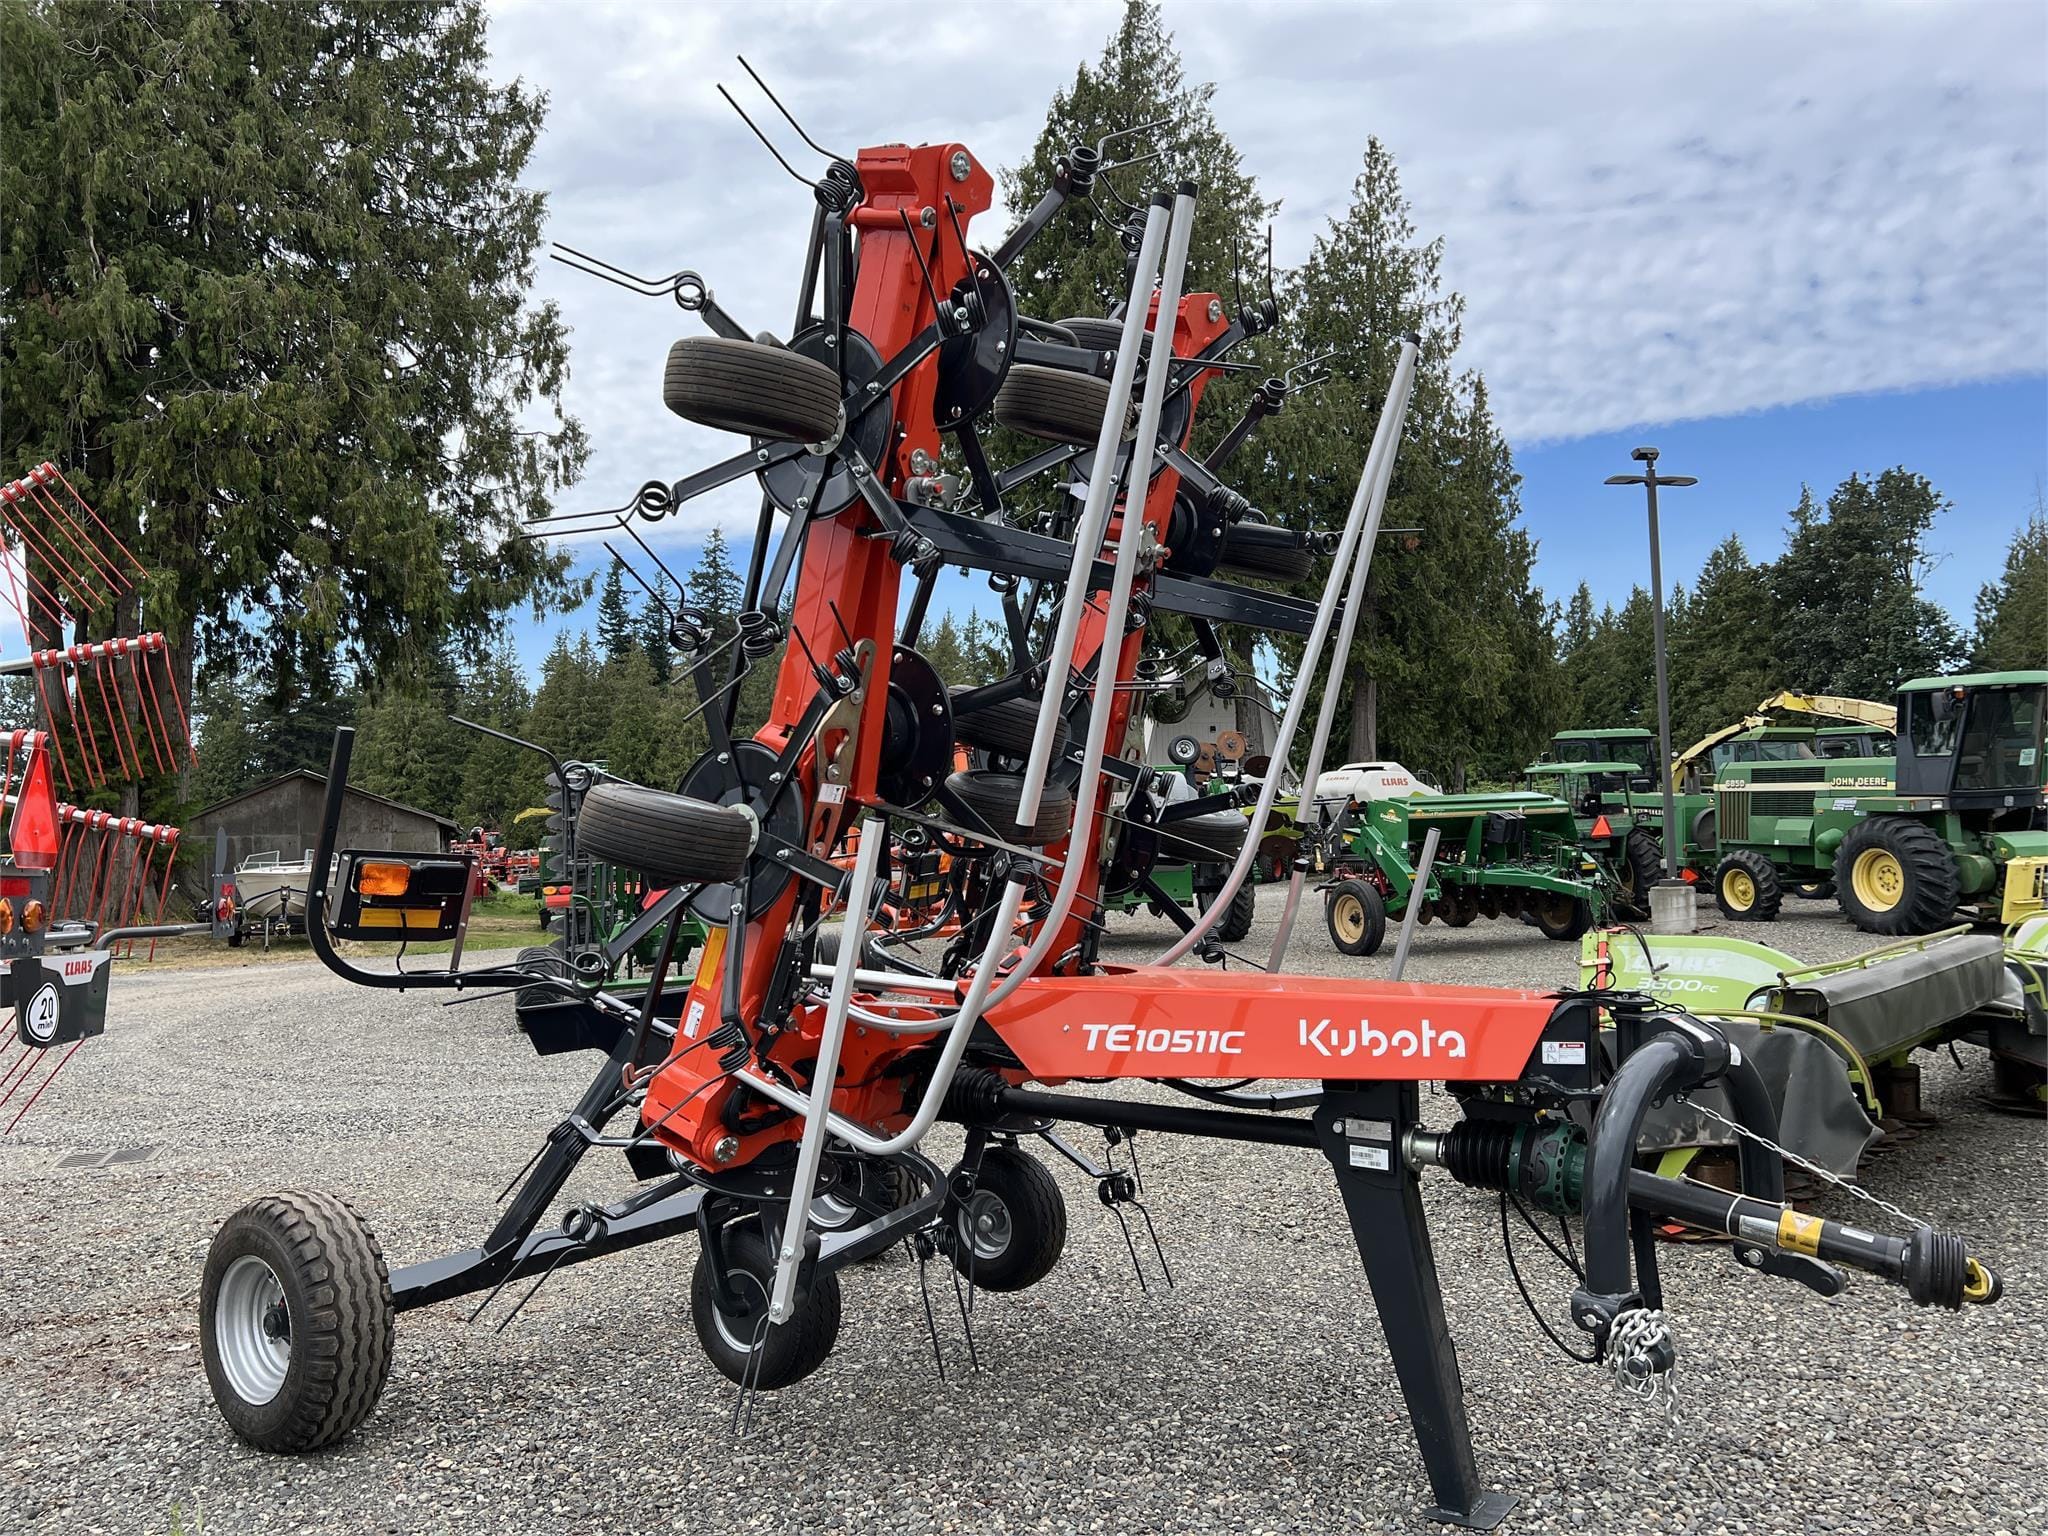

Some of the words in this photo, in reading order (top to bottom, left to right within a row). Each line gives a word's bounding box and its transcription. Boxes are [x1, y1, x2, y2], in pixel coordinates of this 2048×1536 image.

[1381, 777, 1409, 786] CLAAS
[1831, 777, 1854, 787] JOHN
[1858, 777, 1887, 787] DEERE
[65, 960, 93, 976] CLAAS
[39, 996, 54, 1020] 20
[1082, 1023, 1246, 1055] TE10511C
[1299, 1018, 1467, 1058] Kubota
